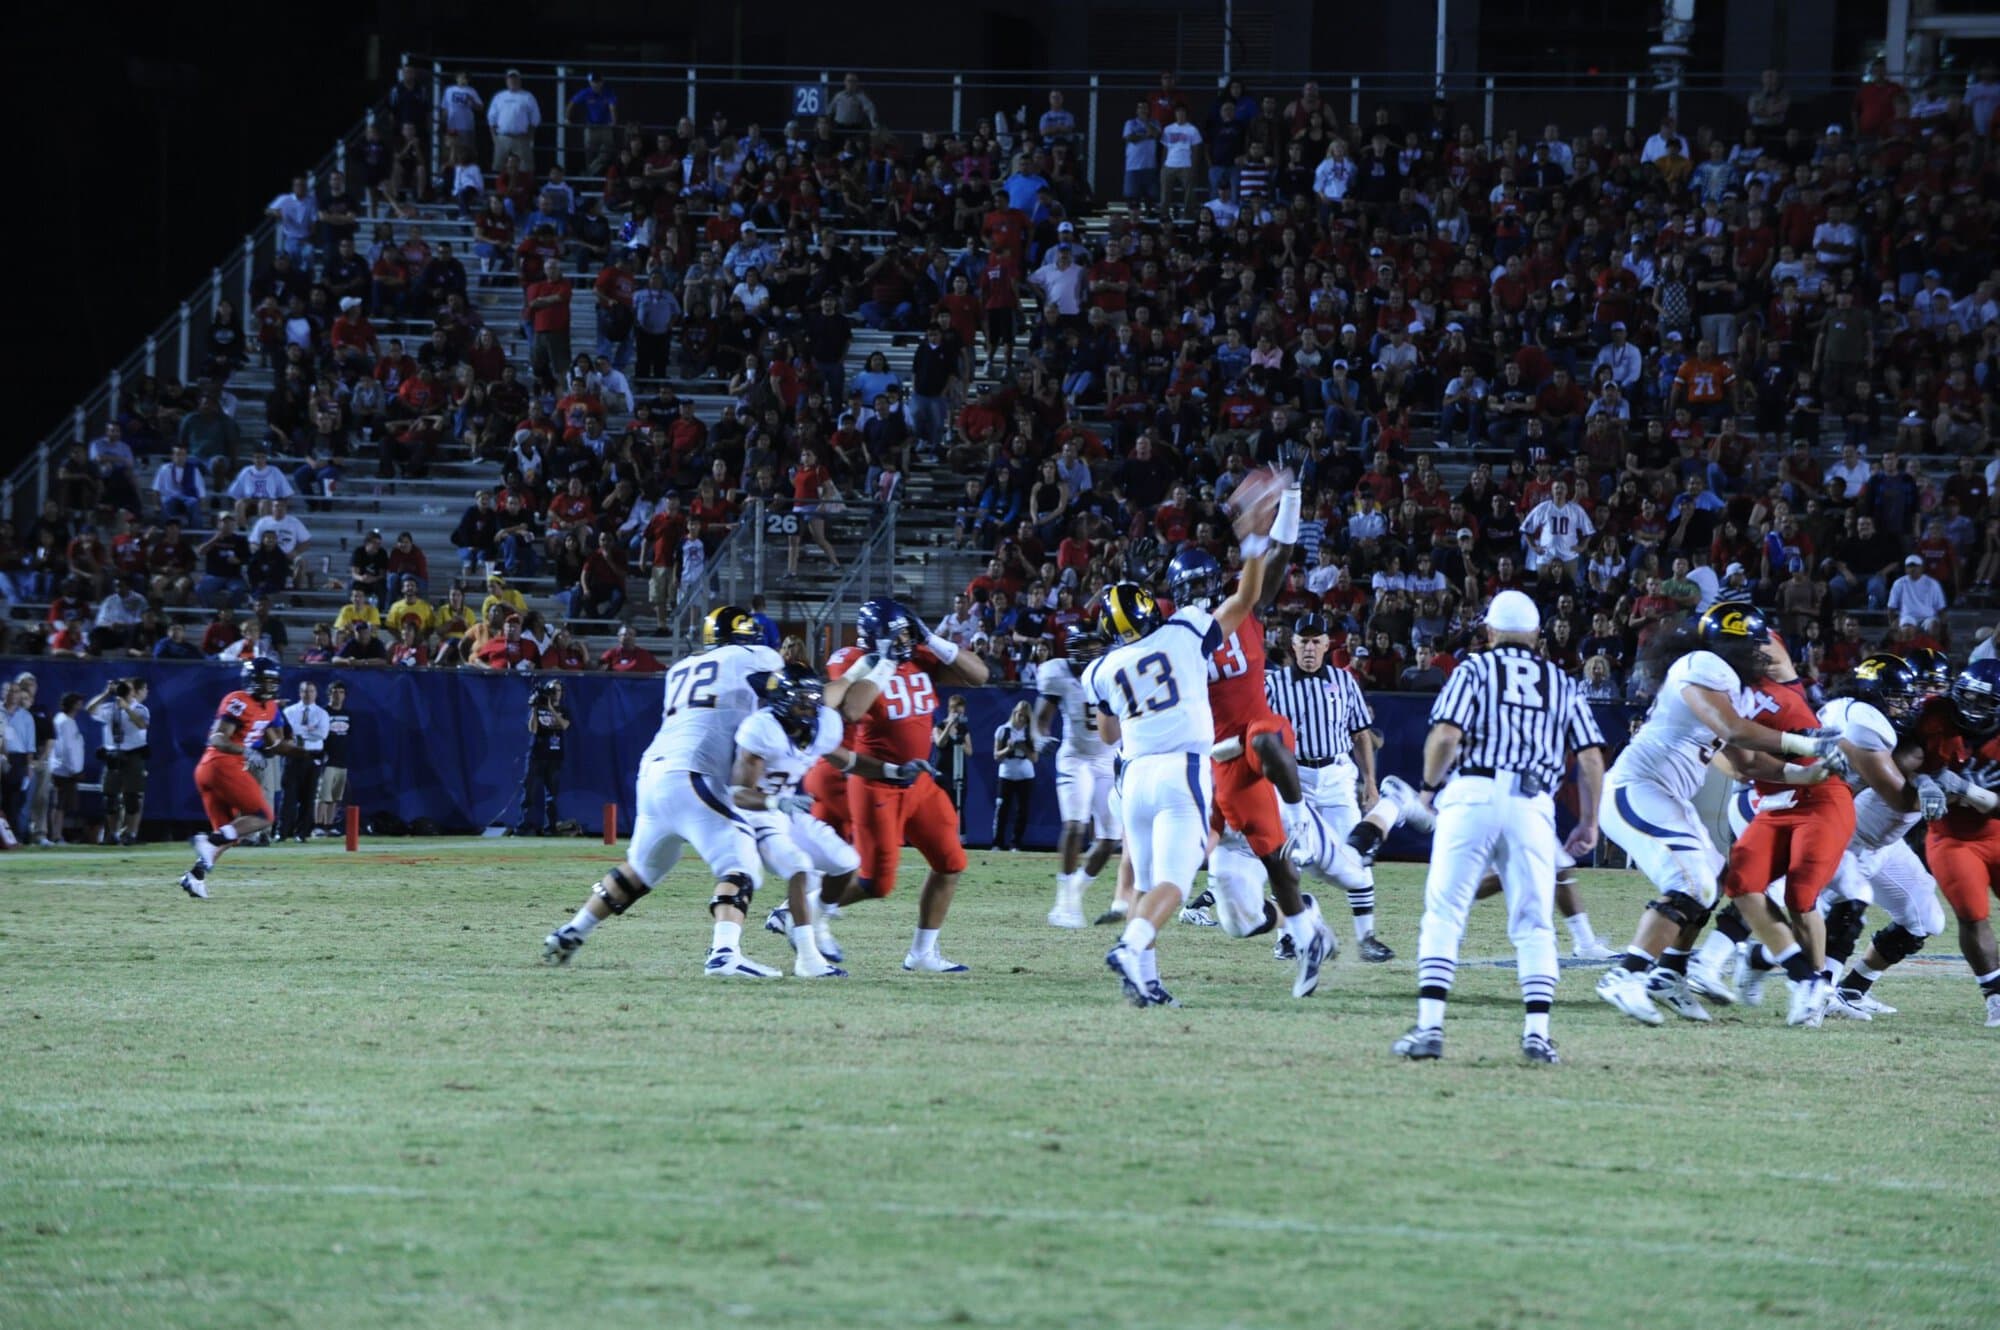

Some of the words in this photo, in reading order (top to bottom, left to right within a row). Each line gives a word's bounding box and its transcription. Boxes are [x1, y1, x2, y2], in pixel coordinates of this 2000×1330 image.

[796, 88, 819, 113] 26
[1694, 377, 1715, 396] 71
[767, 514, 798, 534] 26
[1551, 516, 1570, 535] 10
[667, 661, 718, 715] 72
[883, 672, 938, 720] 92
[1115, 652, 1179, 718] 13
[1501, 655, 1543, 707] R
